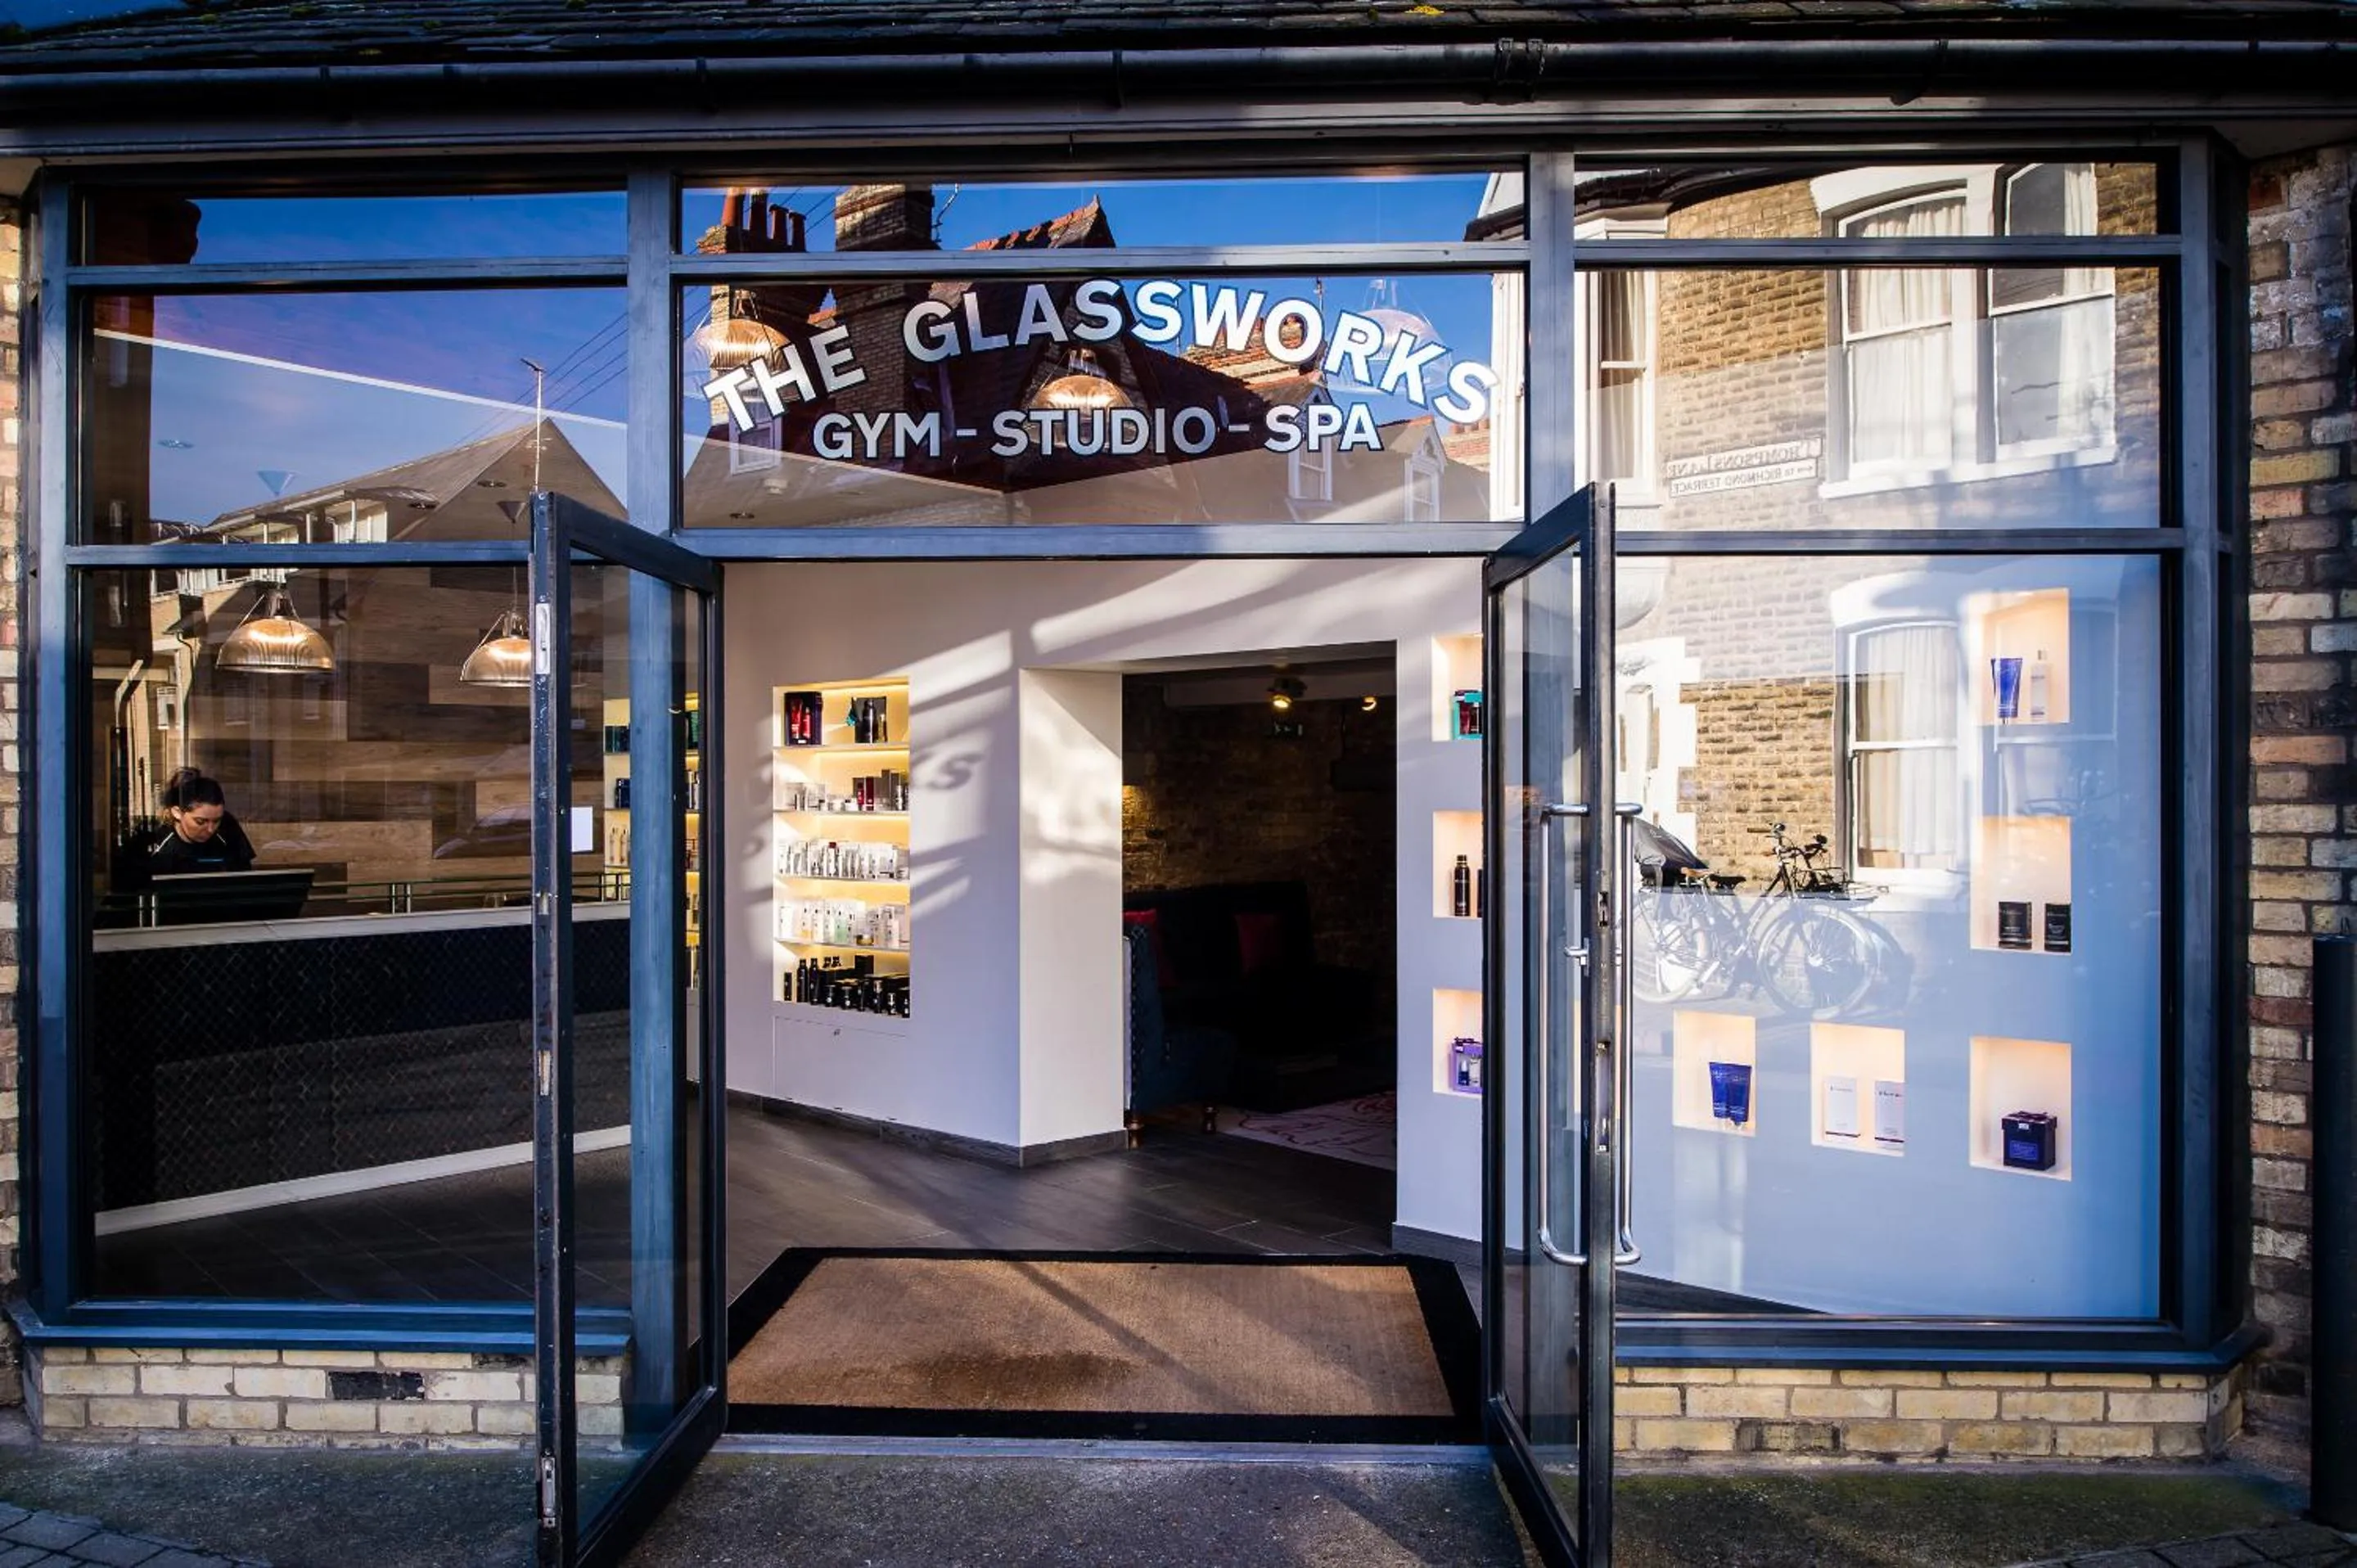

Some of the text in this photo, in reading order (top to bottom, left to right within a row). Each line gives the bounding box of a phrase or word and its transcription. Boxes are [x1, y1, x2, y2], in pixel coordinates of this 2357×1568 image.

[702, 279, 1499, 435] THE GLASSWORKS
[812, 409, 942, 461] GYM
[989, 404, 1216, 457] STUDIO
[1263, 402, 1385, 453] SPA
